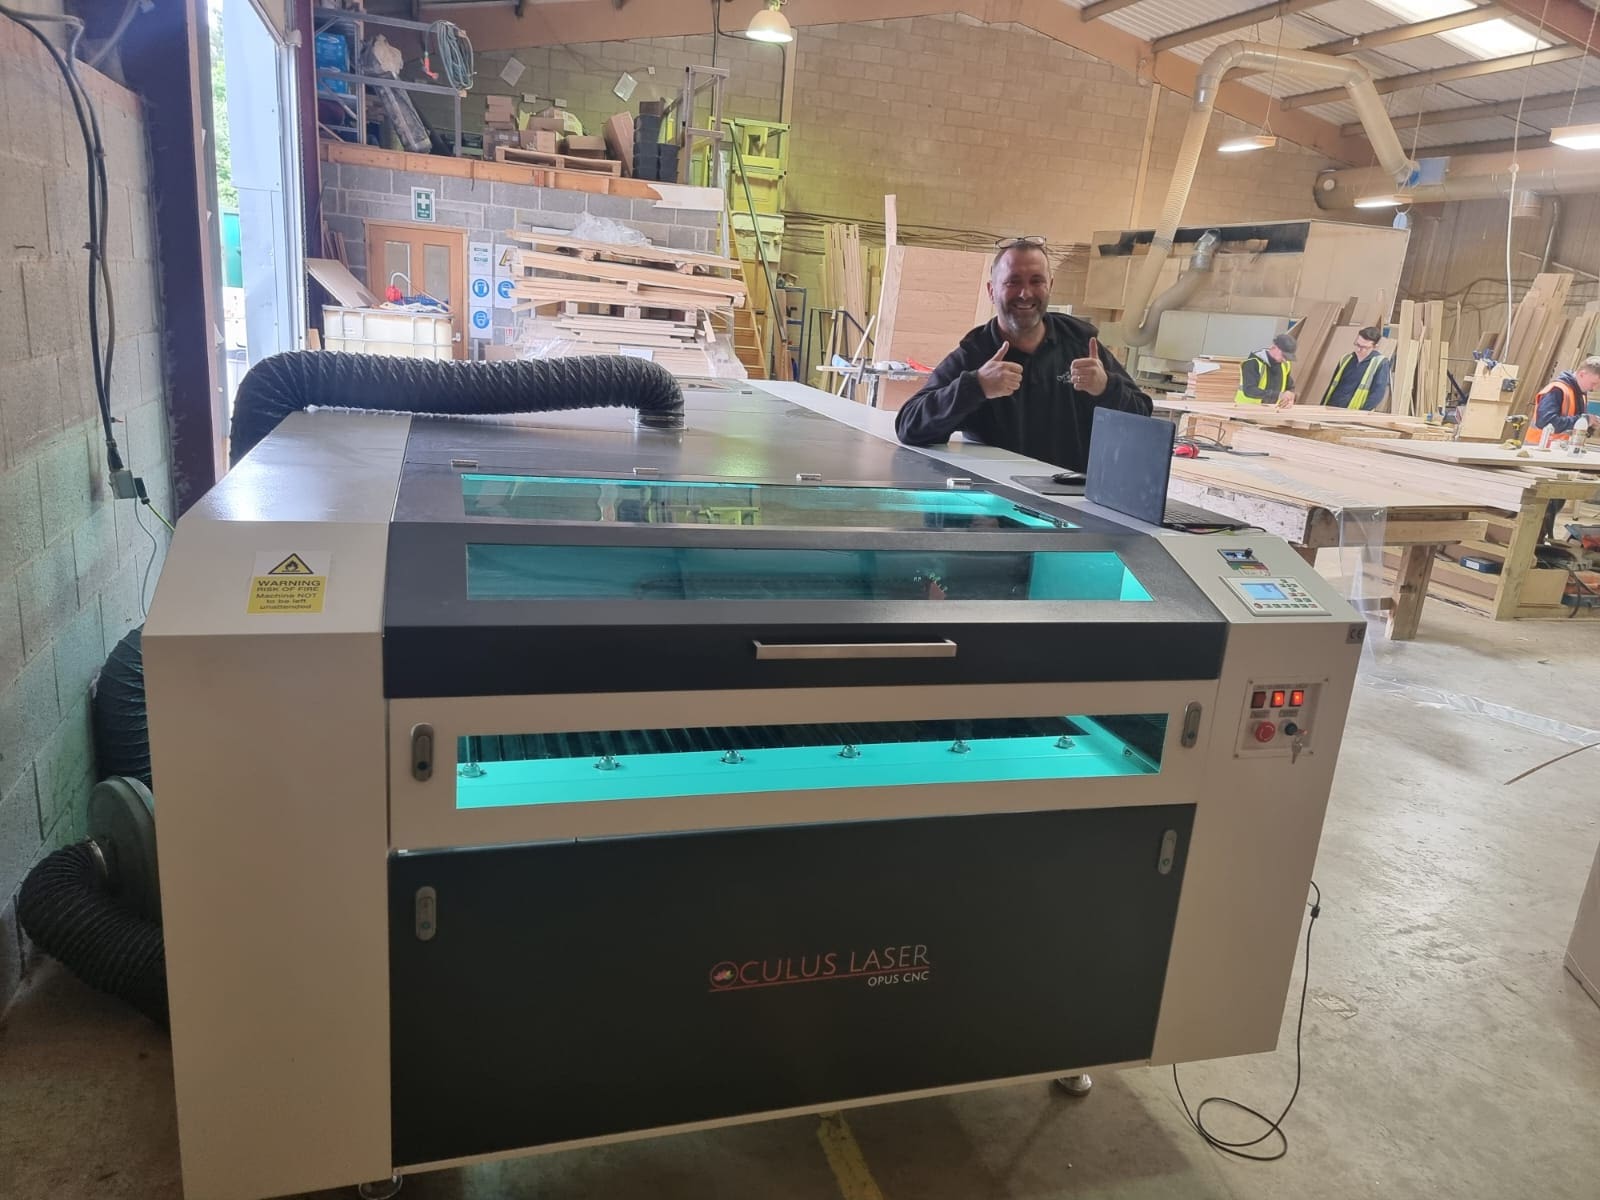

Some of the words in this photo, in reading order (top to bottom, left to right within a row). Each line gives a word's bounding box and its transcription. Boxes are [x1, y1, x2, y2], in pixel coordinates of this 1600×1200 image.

[1350, 628, 1363, 639] CE
[710, 952, 838, 987] OCULUS
[850, 944, 931, 973] LASER
[867, 975, 900, 988] OPUS
[902, 970, 930, 984] CNC
